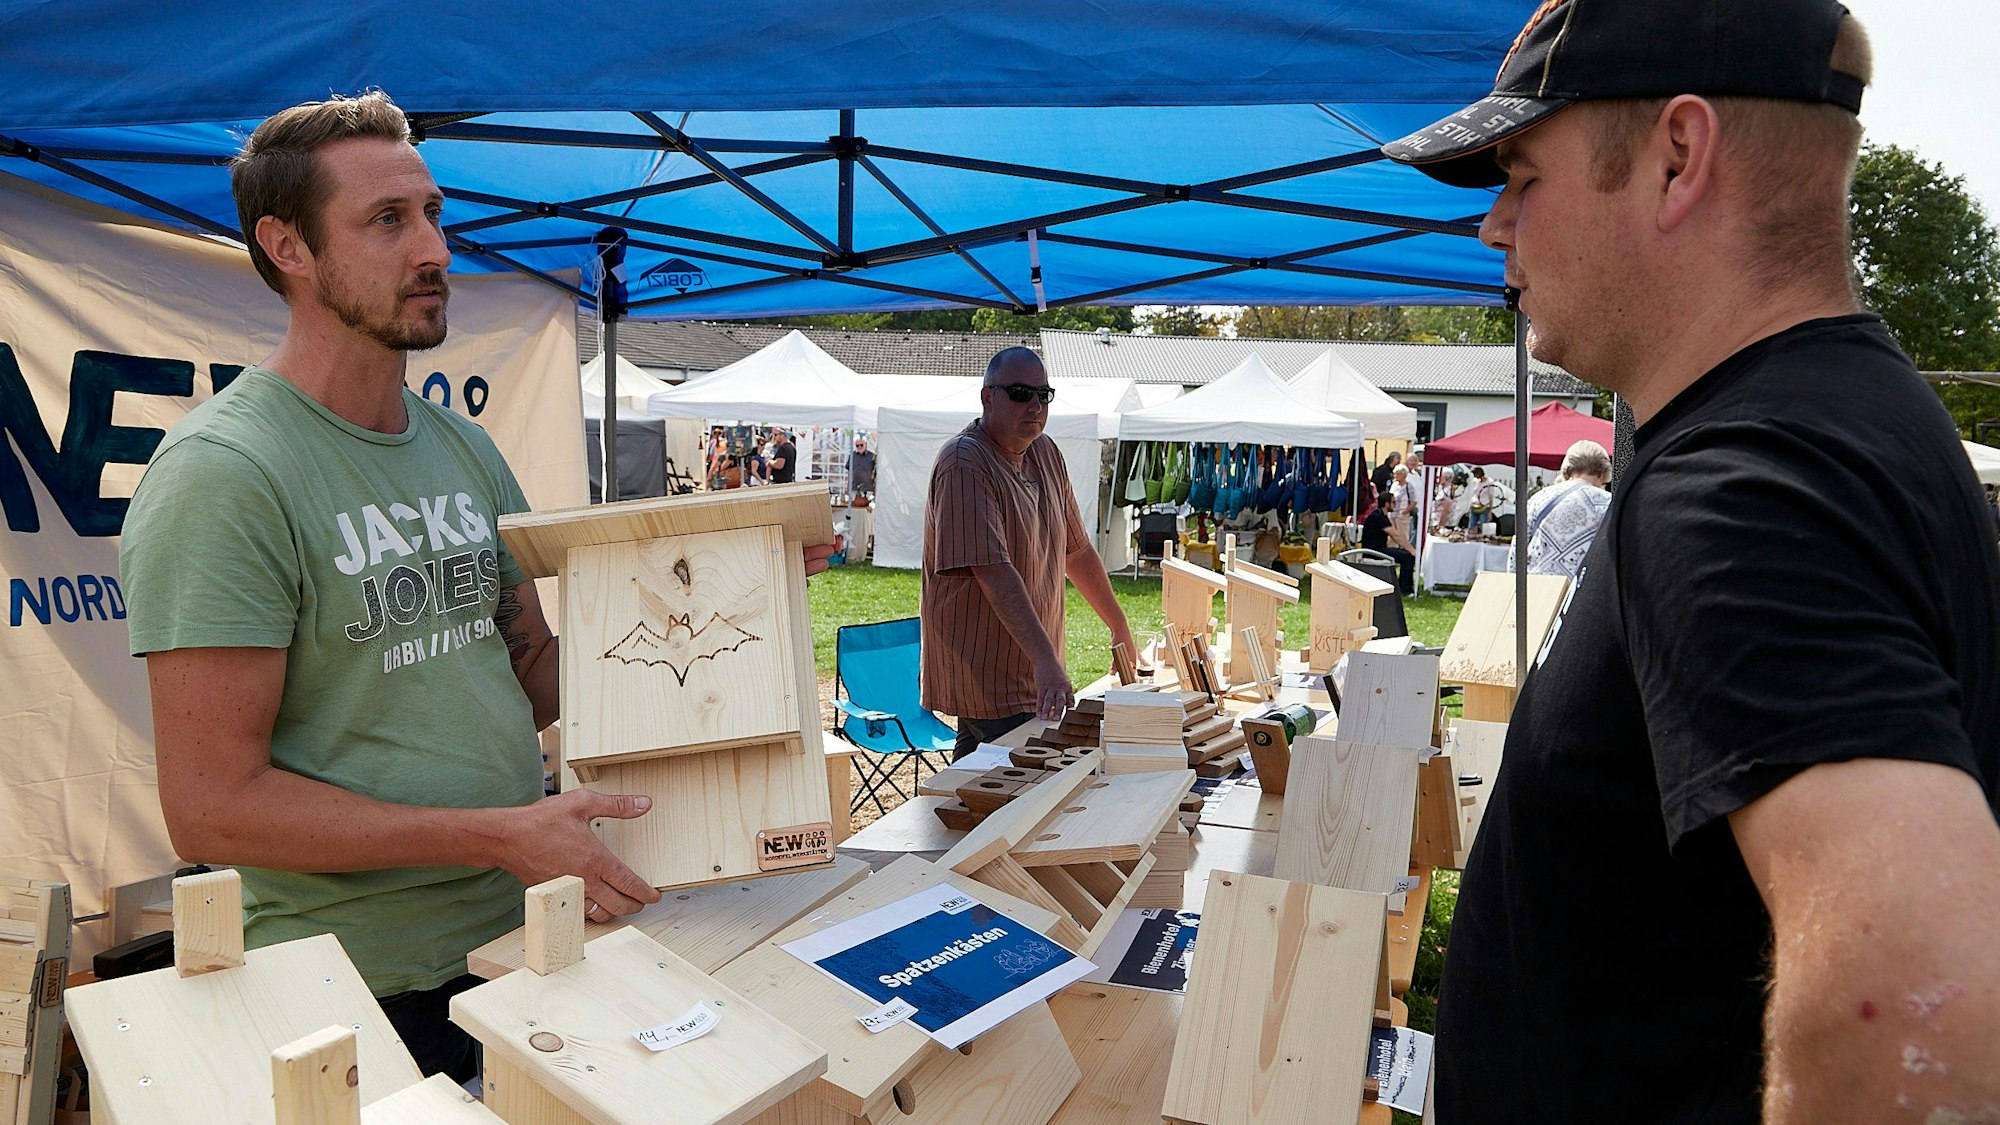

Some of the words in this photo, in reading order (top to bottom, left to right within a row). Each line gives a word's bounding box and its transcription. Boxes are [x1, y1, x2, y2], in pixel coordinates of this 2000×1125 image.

[1435, 122, 1486, 146] STIH
[0, 341, 246, 537] NE
[879, 927, 1009, 988] Spatzenkästen
[1140, 922, 1181, 975] Bienenhotel
